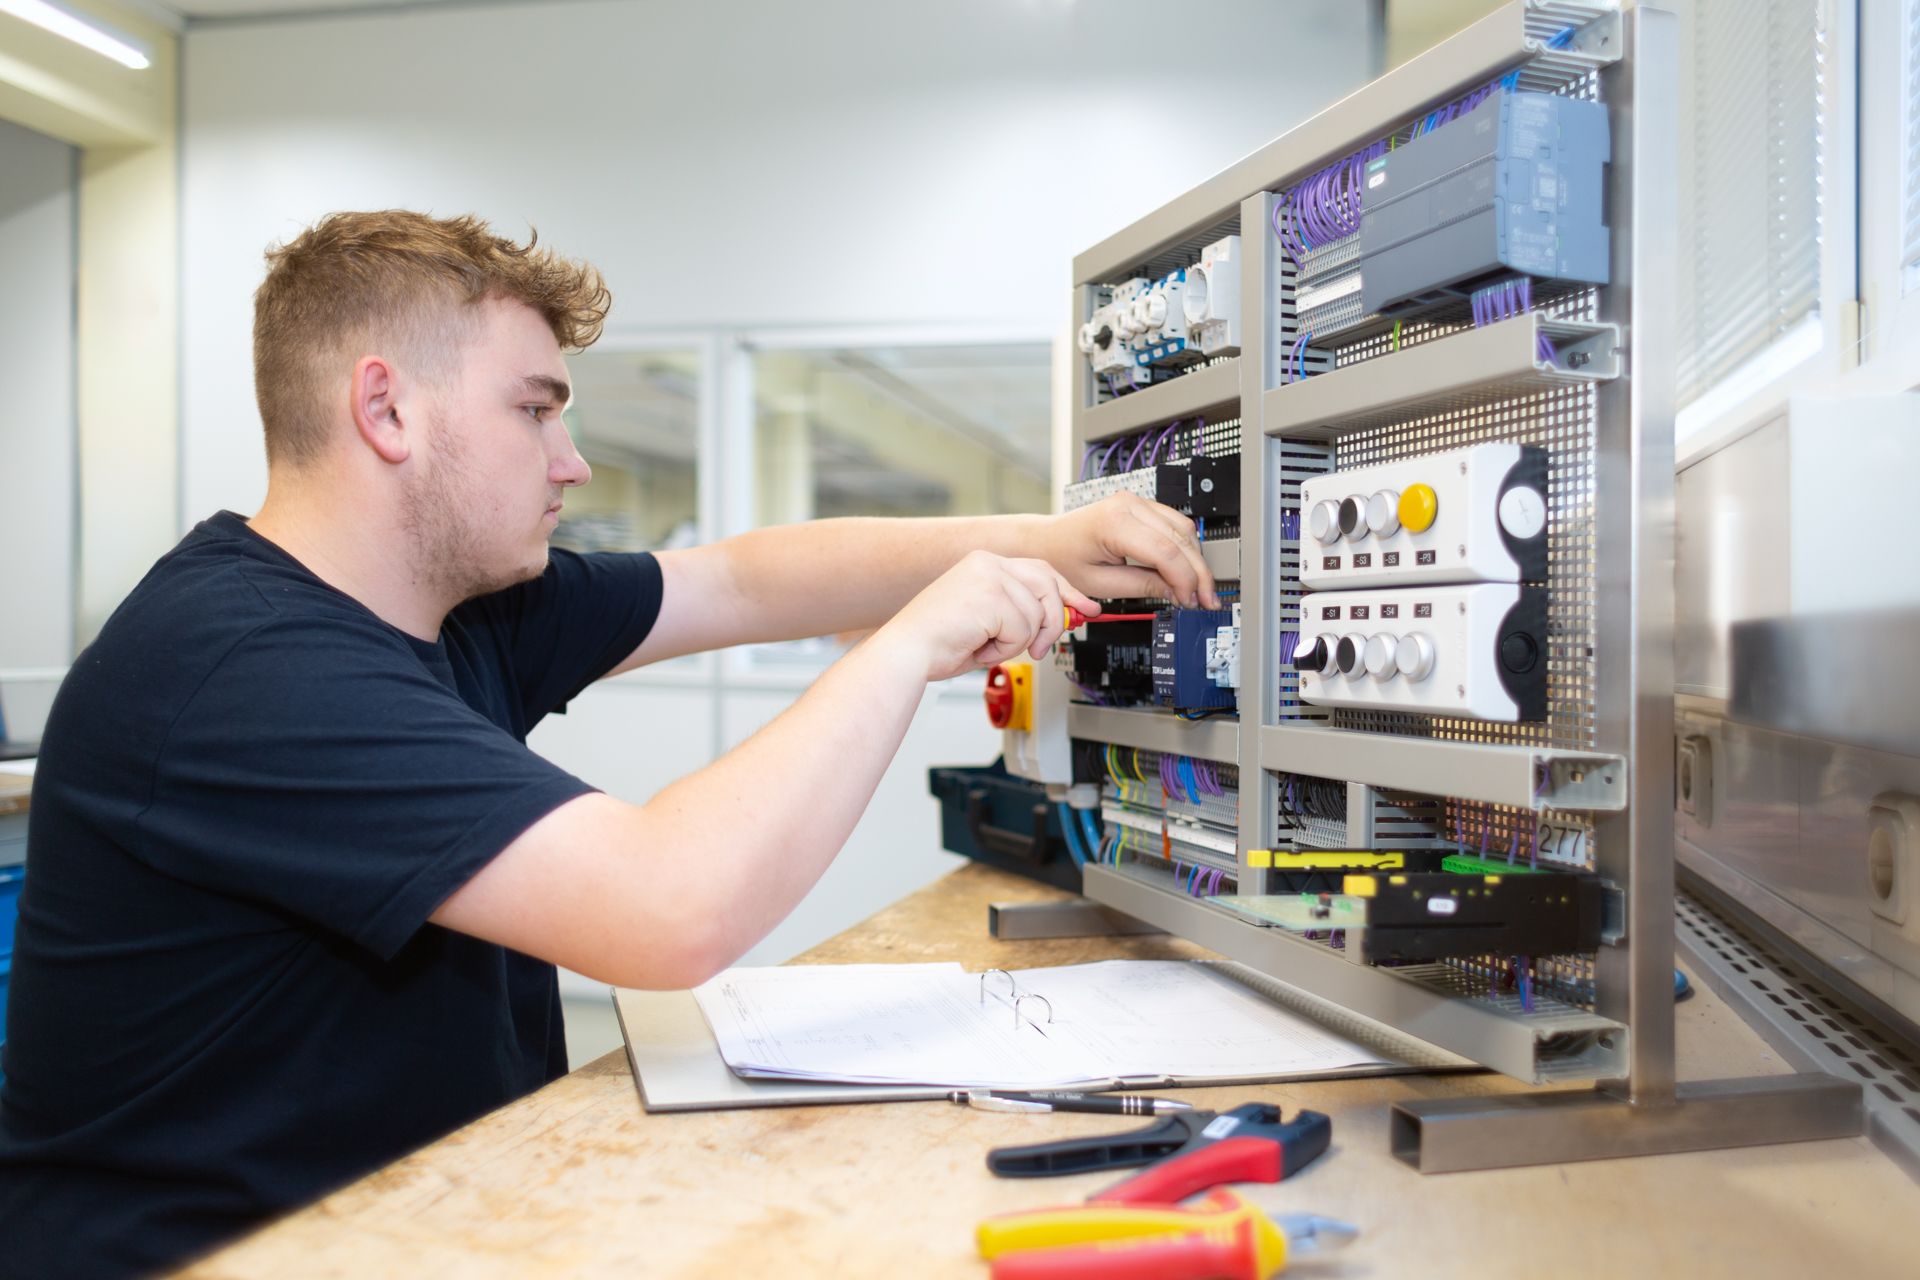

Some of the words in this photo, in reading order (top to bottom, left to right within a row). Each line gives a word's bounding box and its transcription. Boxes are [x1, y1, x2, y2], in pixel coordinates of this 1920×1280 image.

[1327, 558, 1338, 568] -P1
[1355, 555, 1368, 566] -S3
[1418, 552, 1432, 563] -P3
[1325, 608, 1337, 618] -S1
[1353, 608, 1366, 618] -S2
[1382, 606, 1395, 617] -S4
[1416, 605, 1431, 616] -P2
[1539, 823, 1583, 858] 277
